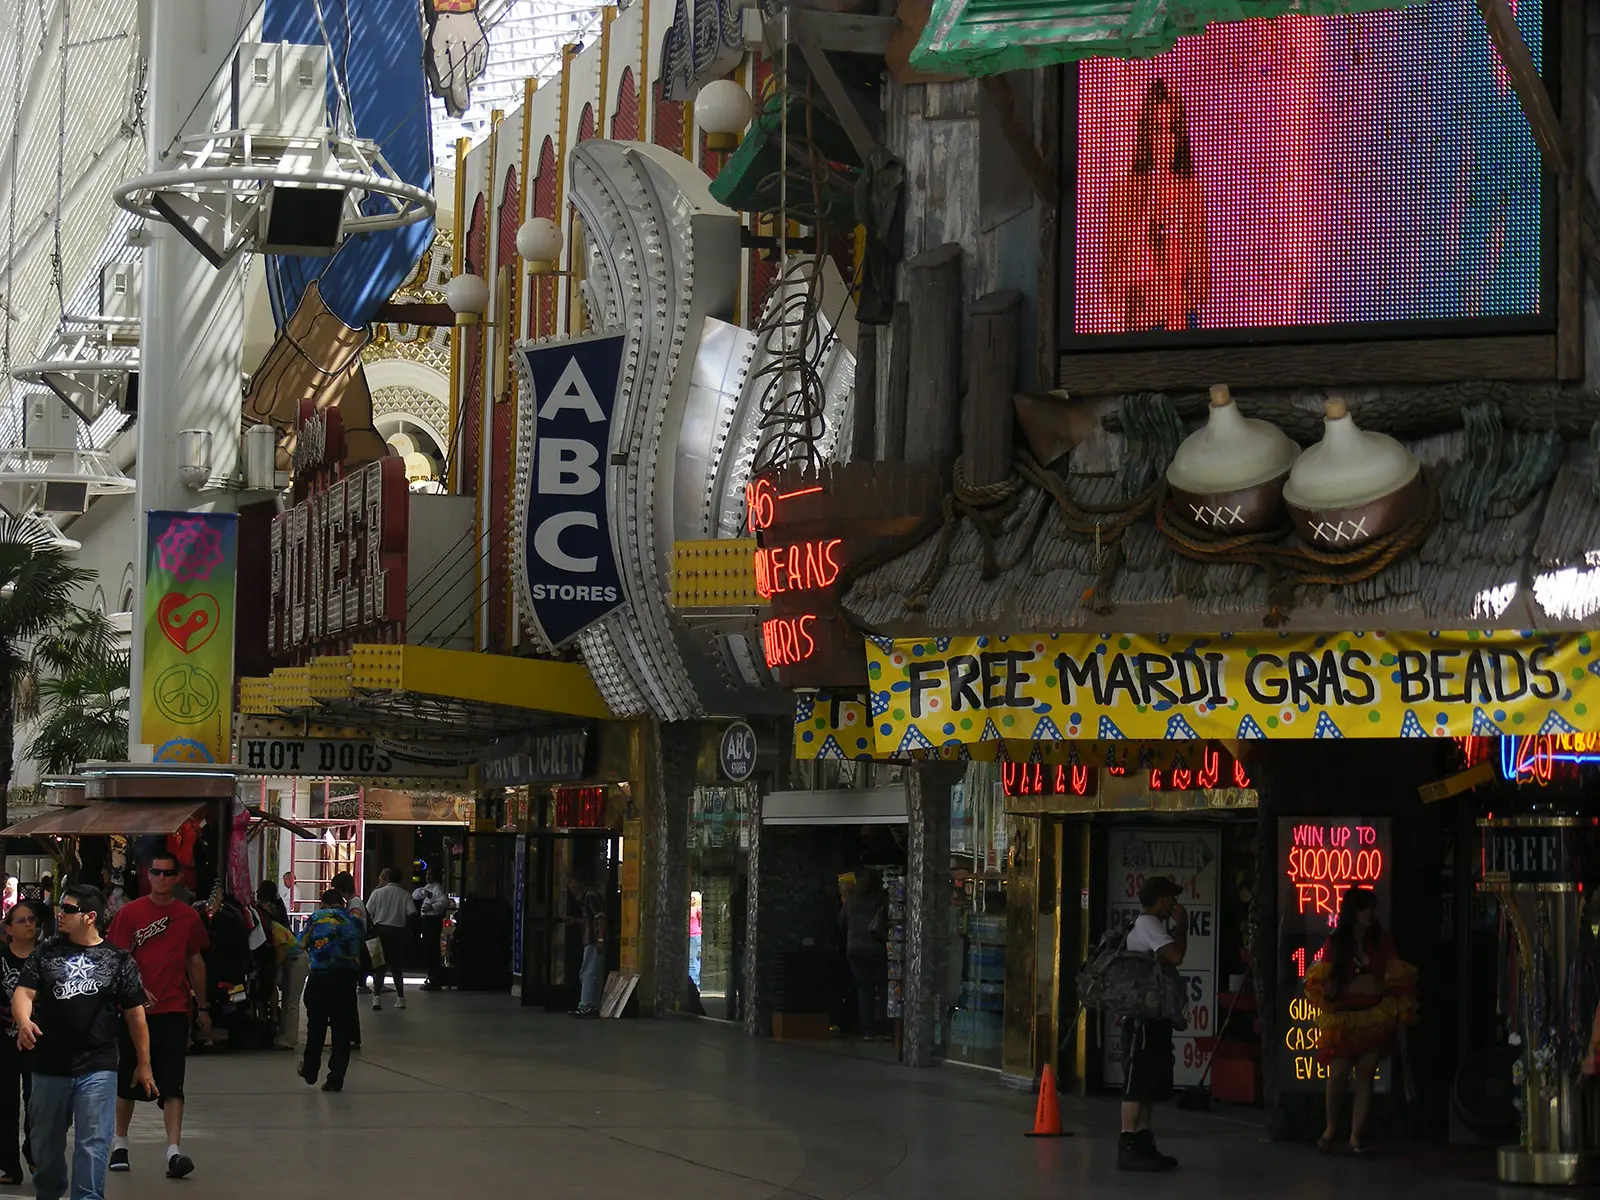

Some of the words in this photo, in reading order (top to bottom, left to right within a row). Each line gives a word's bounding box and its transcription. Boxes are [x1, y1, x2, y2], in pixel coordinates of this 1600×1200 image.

[1189, 503, 1245, 525] XXX
[1308, 516, 1369, 541] XXX
[533, 584, 617, 602] STORES
[909, 651, 1035, 718] FREE
[1058, 651, 1224, 705] MARDI
[1245, 649, 1375, 704] GRAS
[1400, 647, 1560, 703] BEADS
[247, 740, 304, 770] HOT
[319, 742, 393, 773] DOGS
[382, 739, 408, 750] Grand
[410, 746, 443, 757] Canyon
[727, 730, 751, 760] ABC
[731, 762, 747, 774] STORES
[1292, 825, 1324, 847] WIN
[1330, 826, 1352, 848] UP
[1355, 826, 1377, 845] TO
[1151, 842, 1204, 868] WATER
[1491, 835, 1557, 873] FREE
[1295, 883, 1374, 914] FRE
